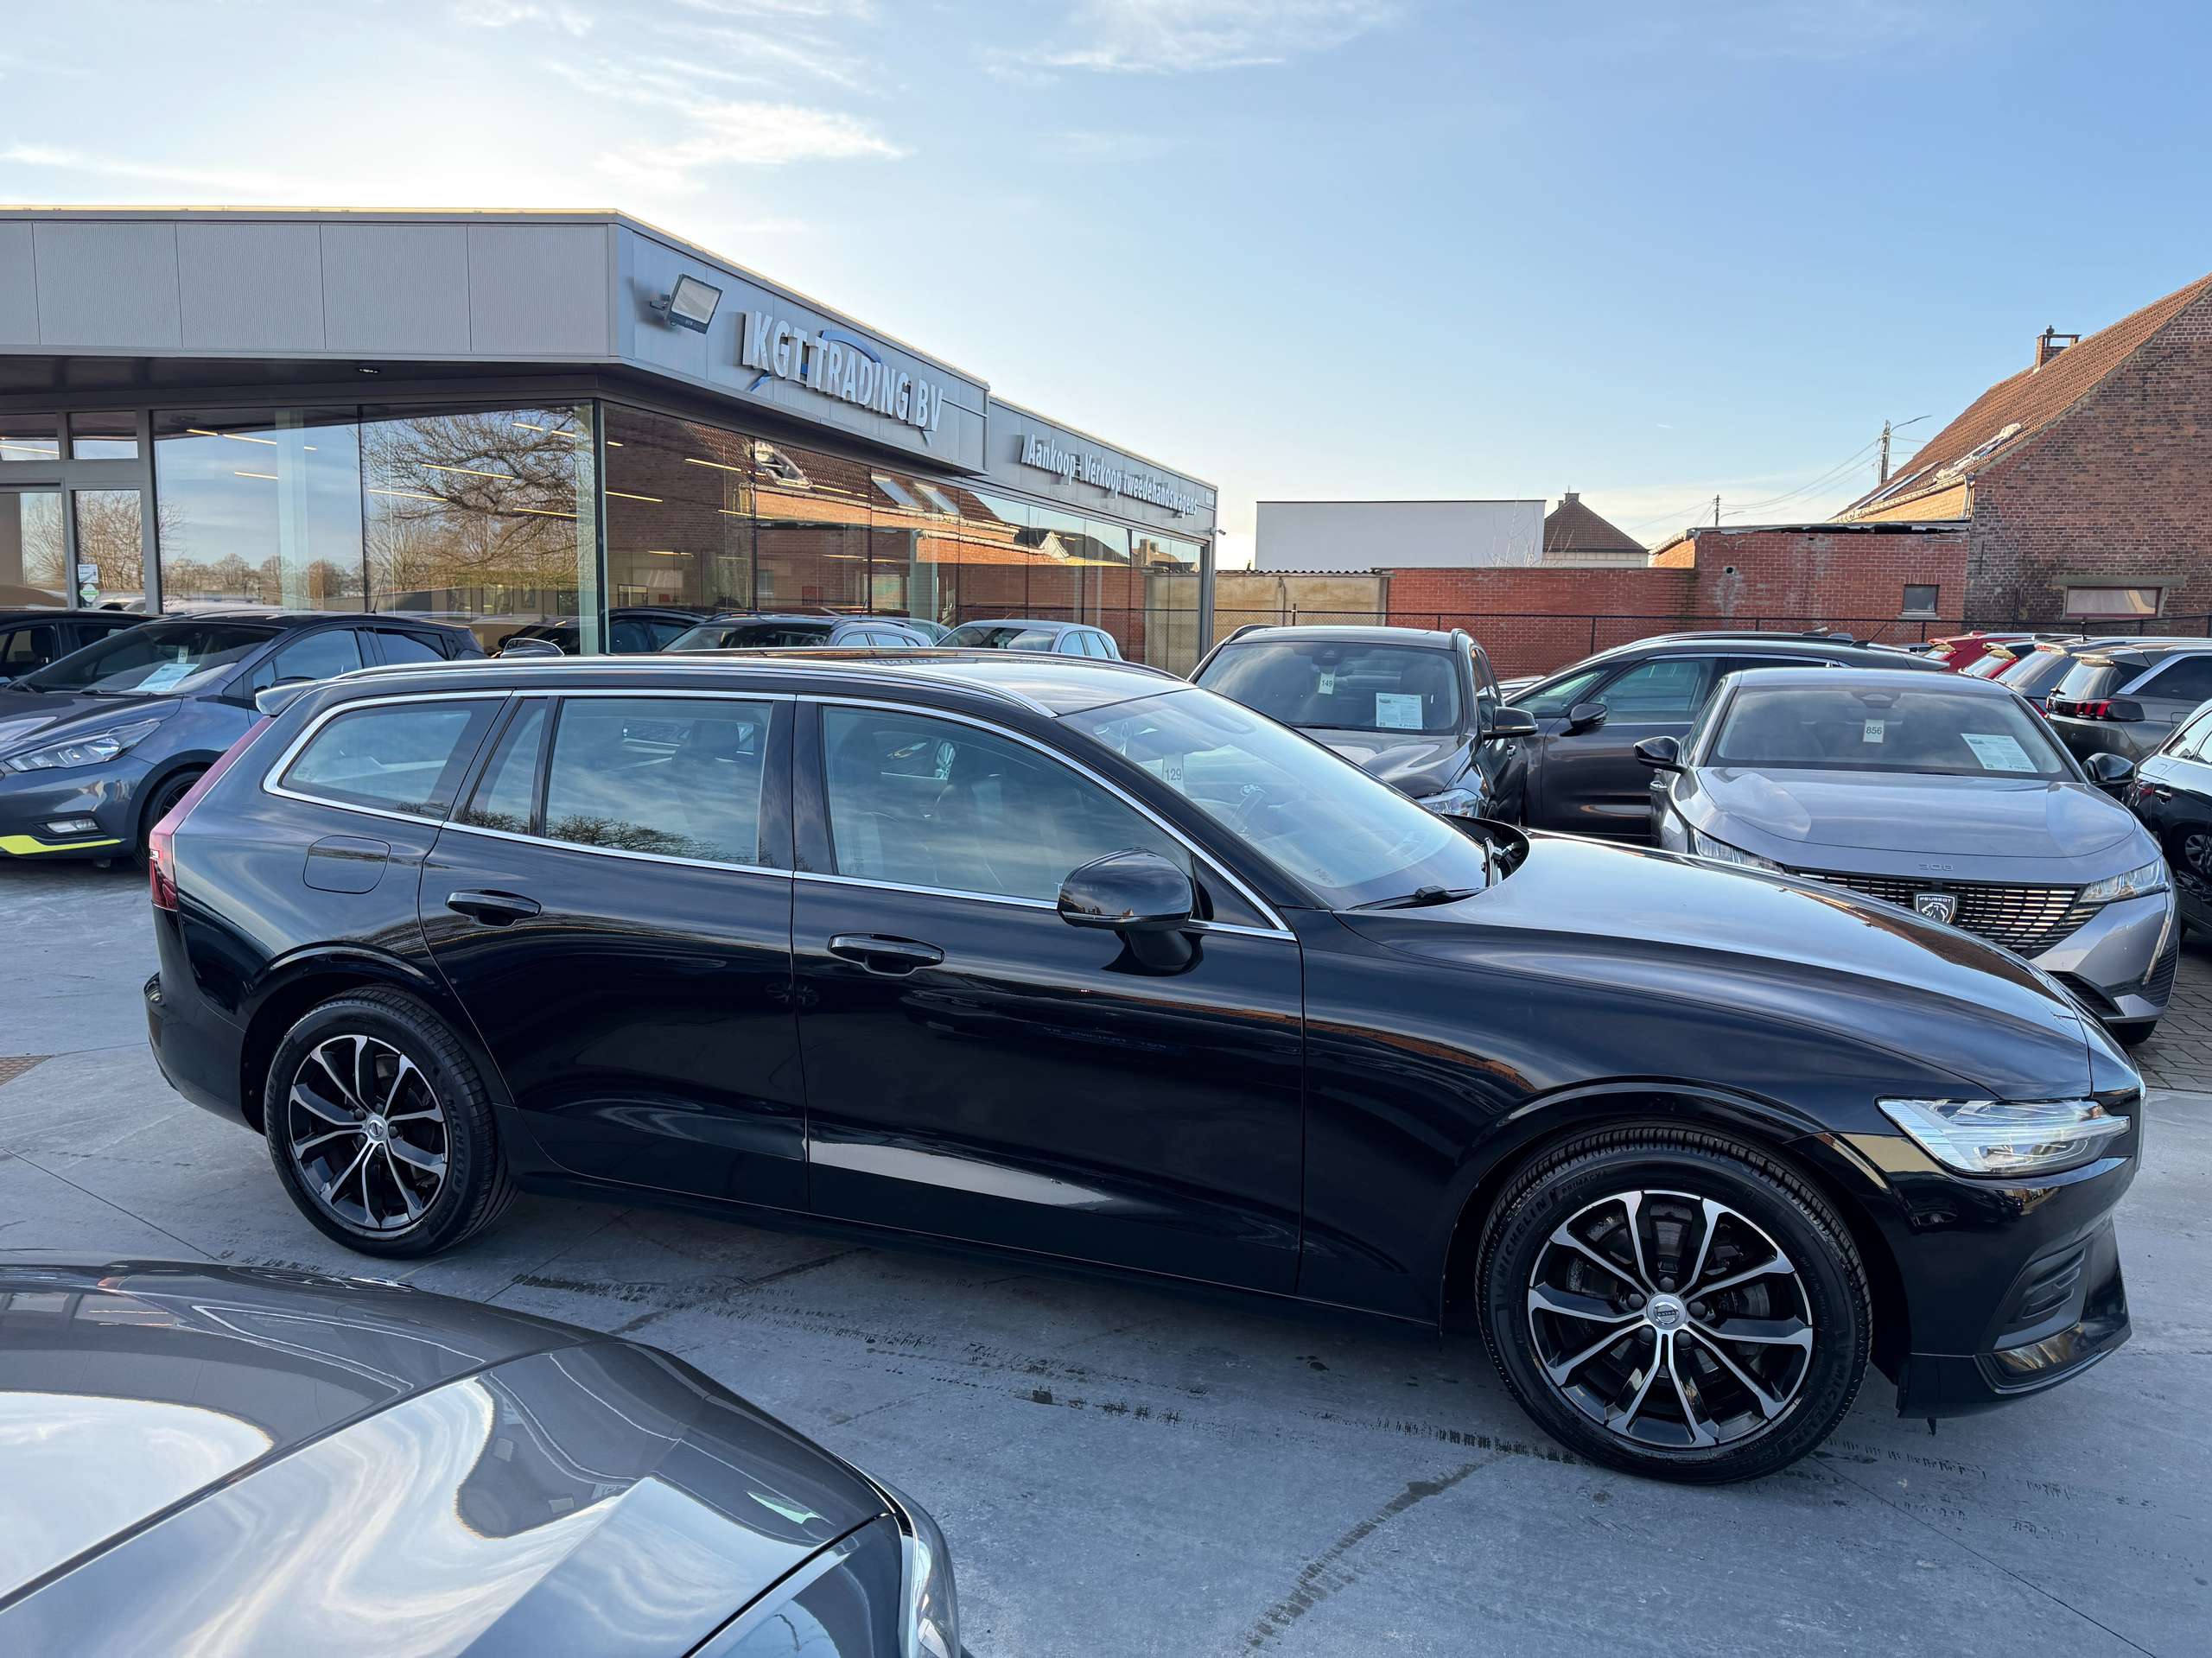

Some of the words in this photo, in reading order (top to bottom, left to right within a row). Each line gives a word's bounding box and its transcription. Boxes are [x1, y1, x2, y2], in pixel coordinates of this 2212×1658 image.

[749, 311, 808, 382] KGT
[812, 336, 912, 422] TRADING
[915, 378, 944, 432] BV
[1027, 434, 1077, 486] Aankoop
[1084, 453, 1122, 499] Verkoop
[1123, 469, 1198, 519] tweedehandswagens
[1866, 726, 1882, 734] 856
[1166, 767, 1182, 781] 129
